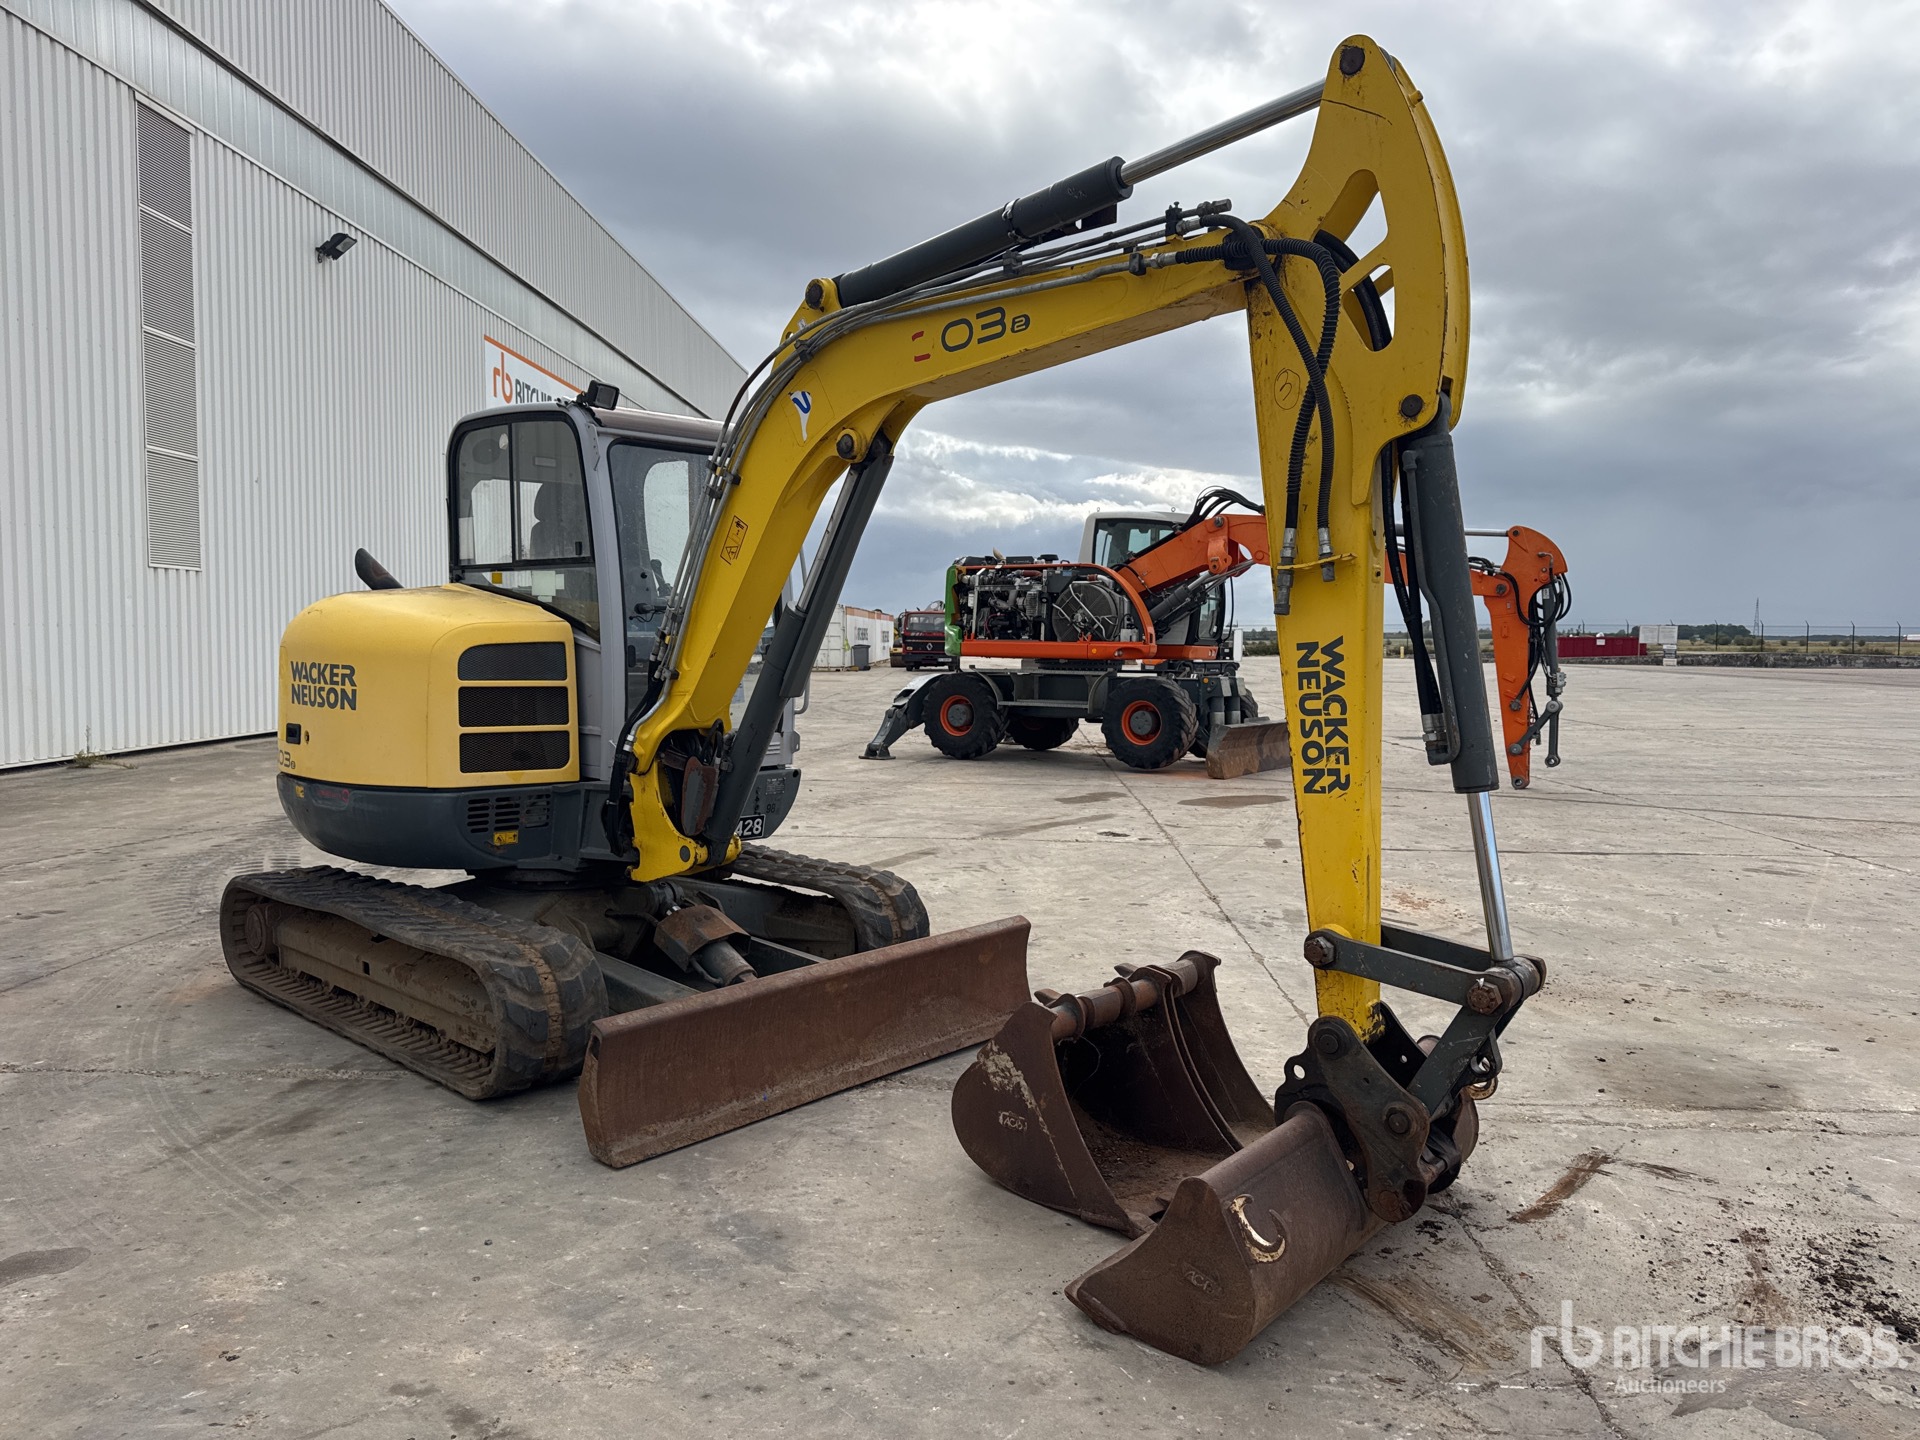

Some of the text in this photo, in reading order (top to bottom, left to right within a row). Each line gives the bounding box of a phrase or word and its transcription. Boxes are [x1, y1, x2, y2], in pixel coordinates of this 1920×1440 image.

[515, 378, 552, 405] RITC
[290, 660, 357, 687] WACKER
[291, 683, 357, 711] NEUSON
[1296, 641, 1327, 795] NEUSON
[1320, 635, 1351, 795] WACKER
